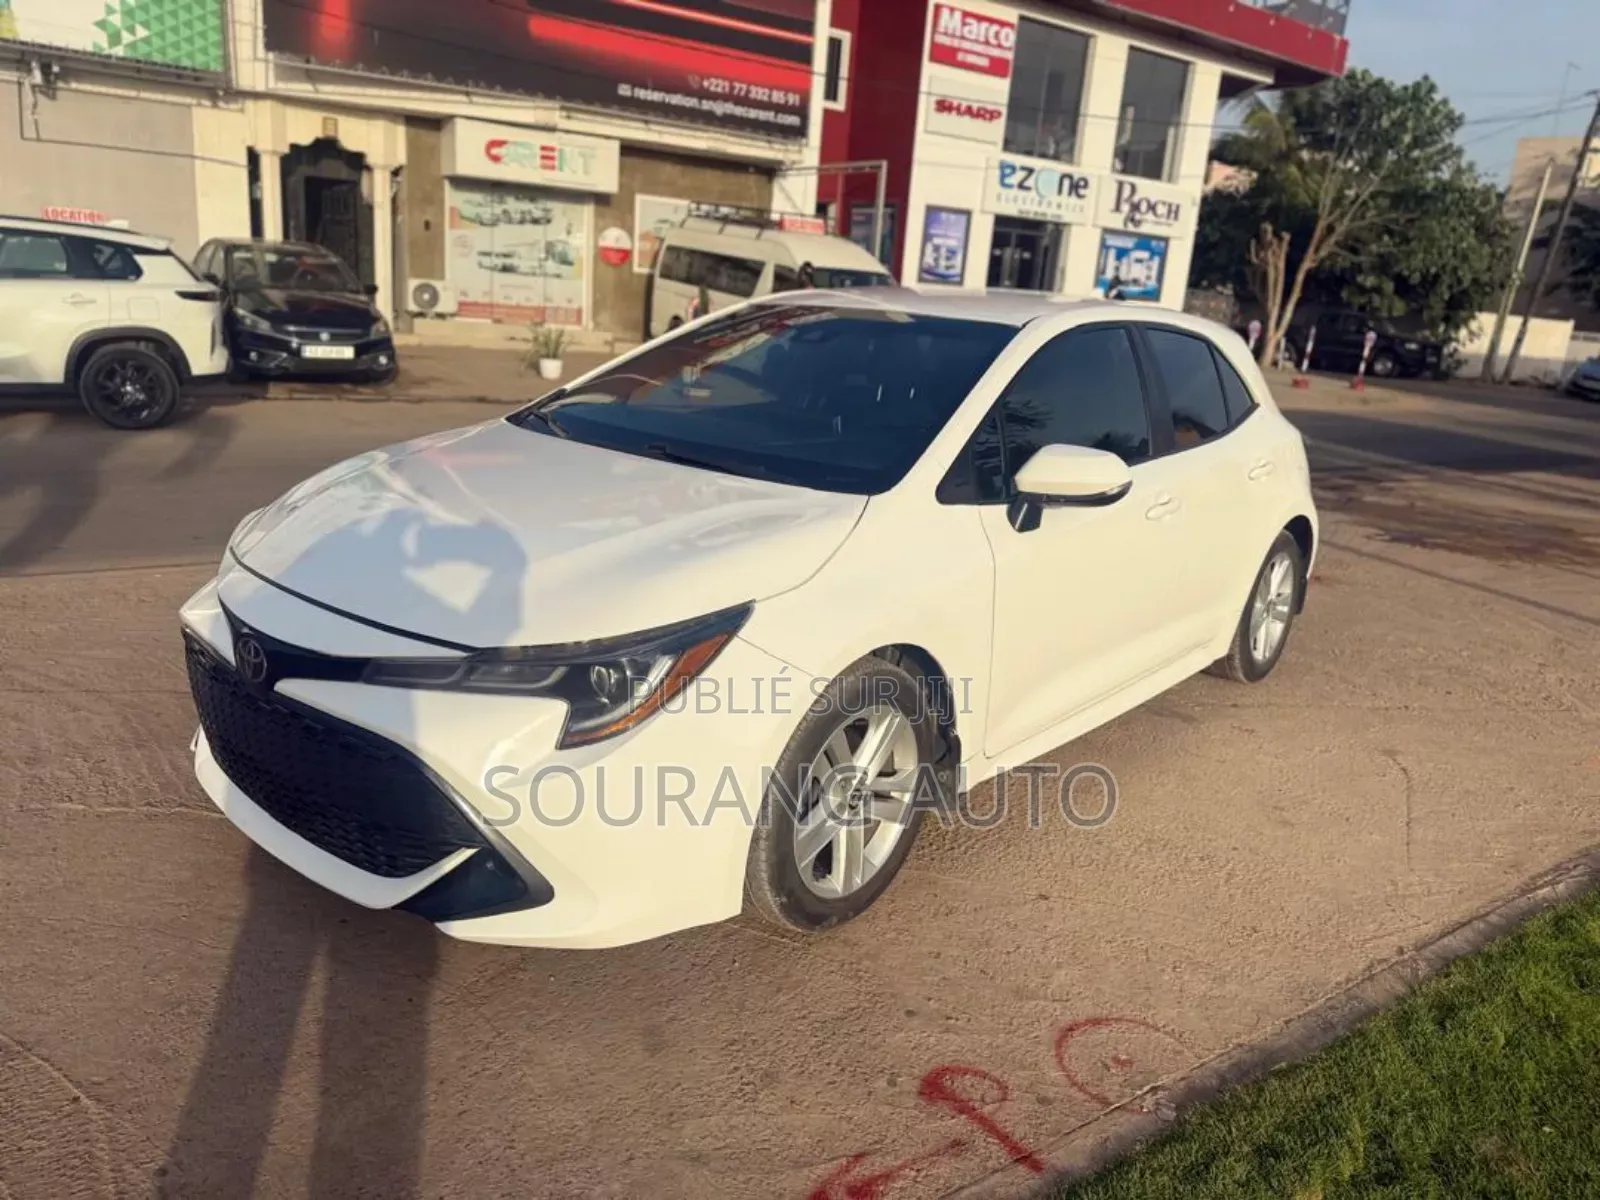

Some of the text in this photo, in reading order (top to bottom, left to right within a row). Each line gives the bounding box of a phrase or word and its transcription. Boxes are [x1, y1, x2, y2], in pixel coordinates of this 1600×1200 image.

[938, 7, 1015, 48] Marco
[702, 77, 730, 94] +221
[732, 82, 748, 97] 77
[934, 98, 1003, 123] SHARP
